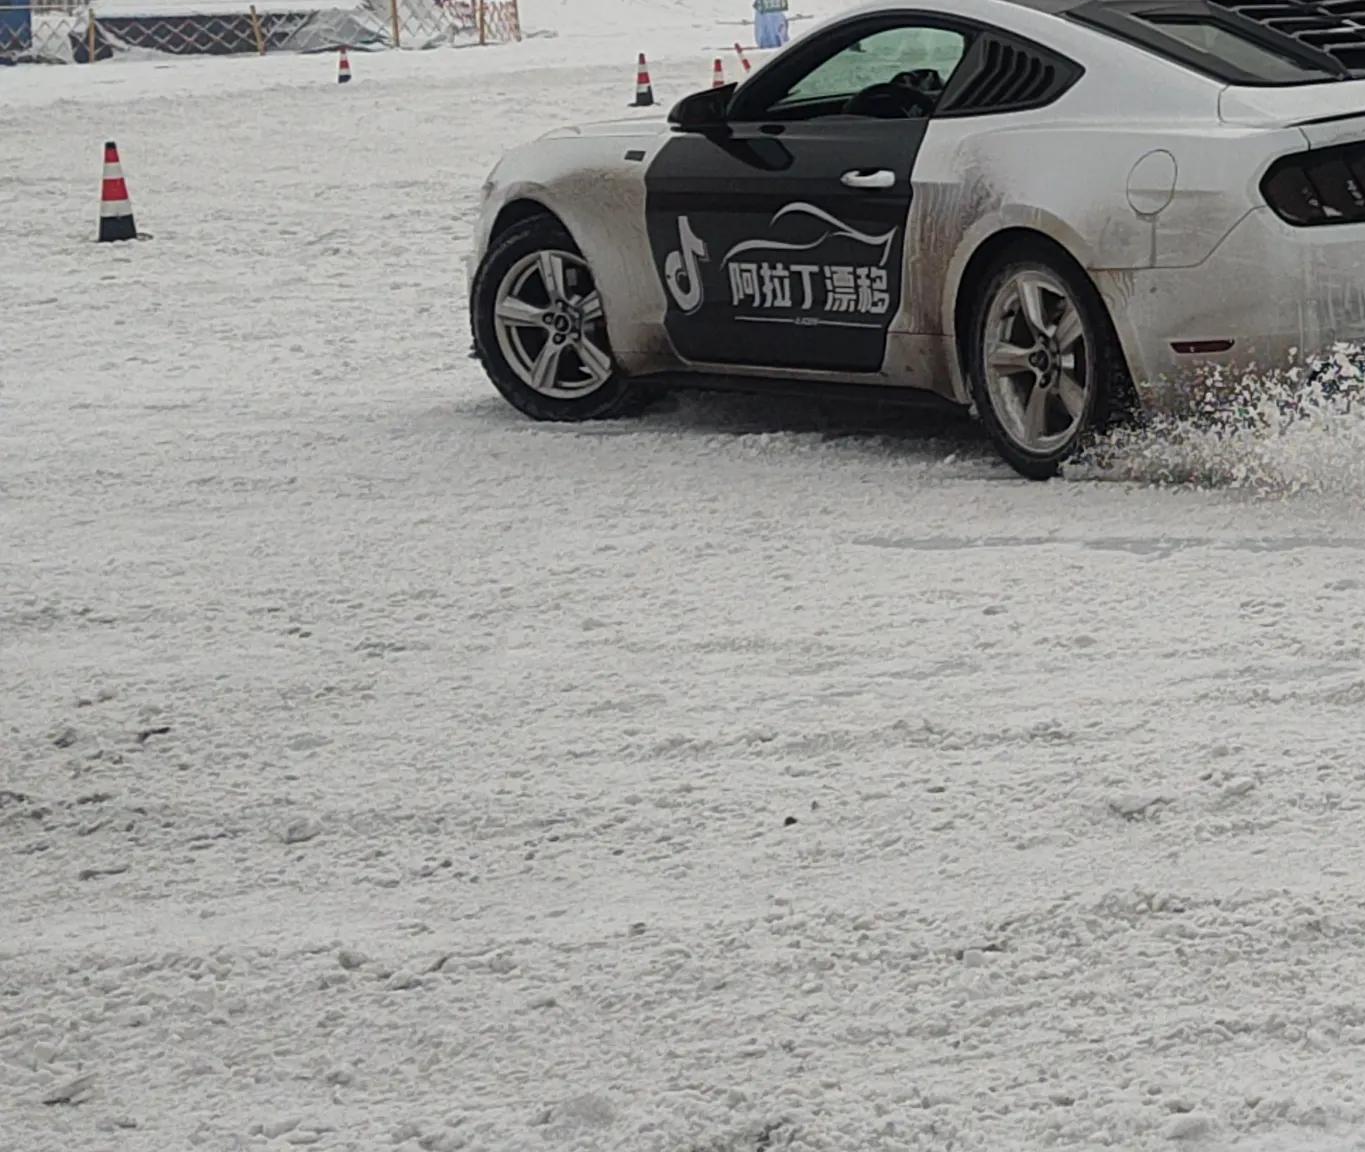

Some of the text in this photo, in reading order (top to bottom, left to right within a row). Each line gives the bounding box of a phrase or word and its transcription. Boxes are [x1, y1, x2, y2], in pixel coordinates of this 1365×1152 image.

[728, 262, 890, 314] 阿拉丁漂移
